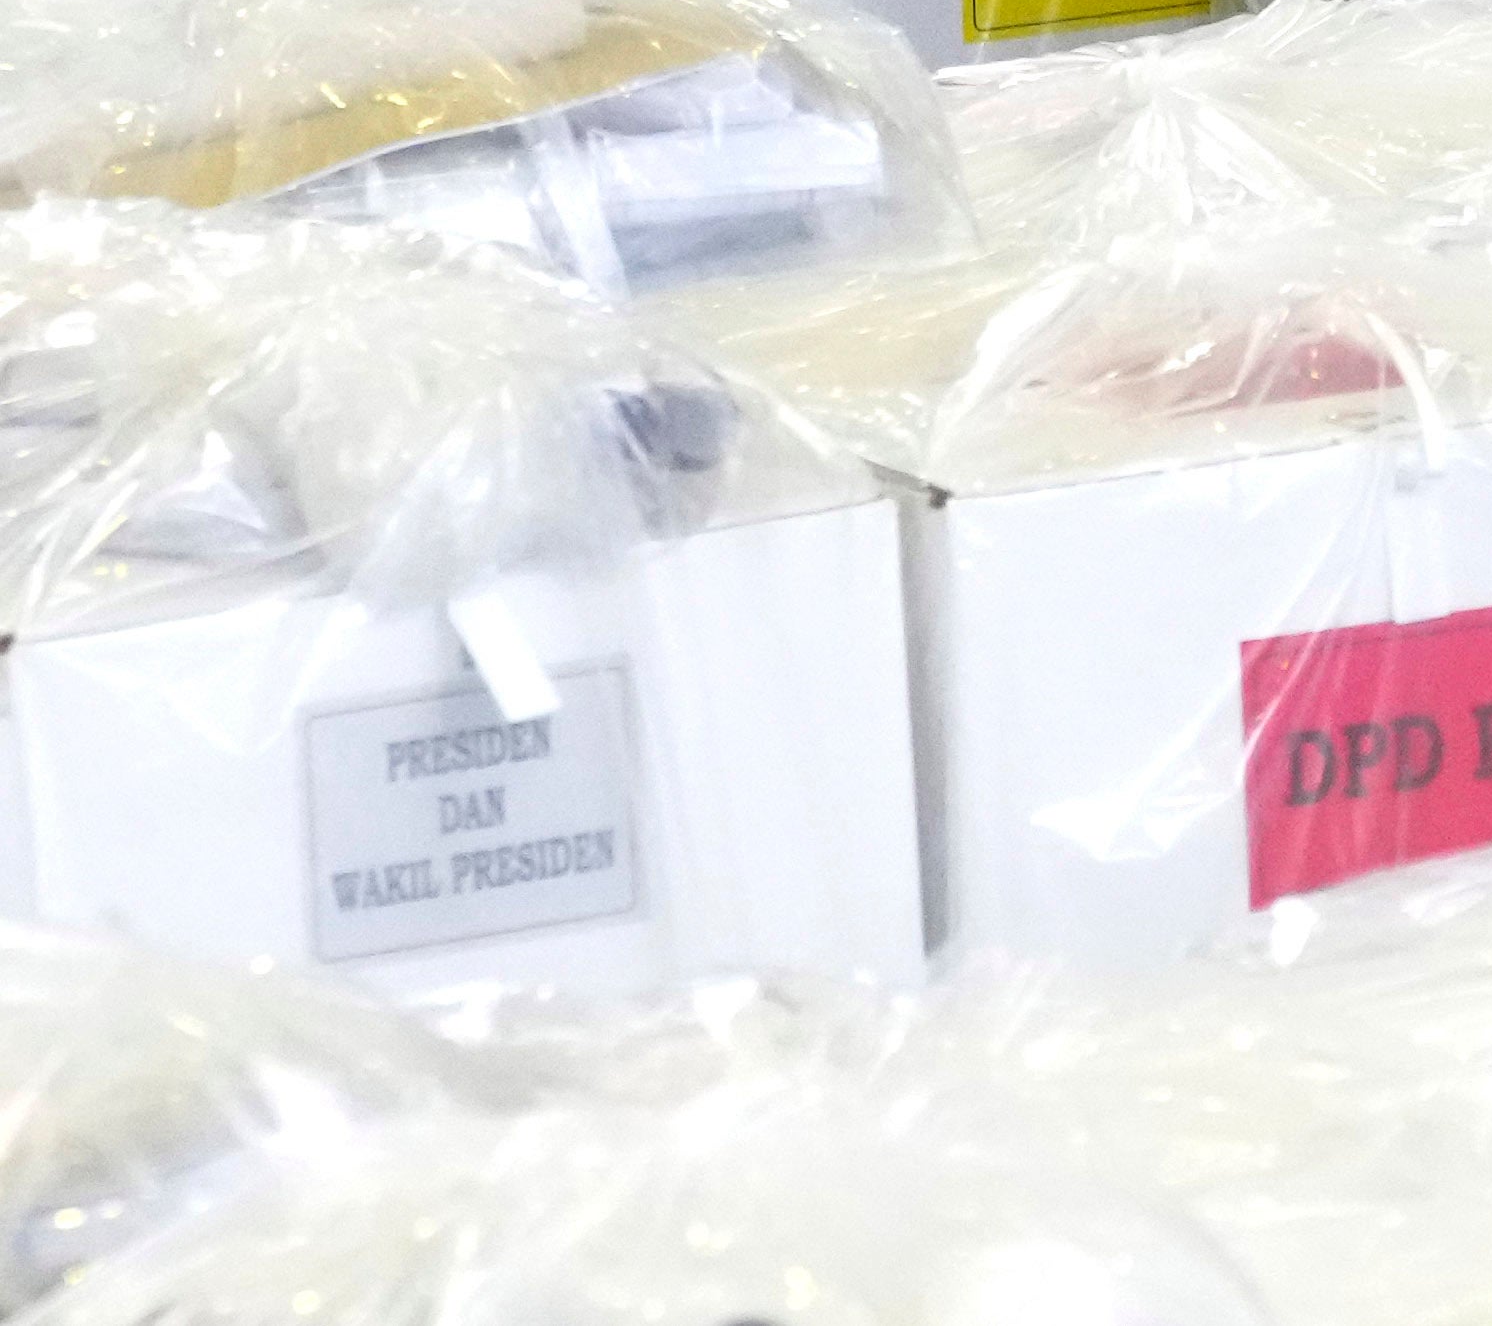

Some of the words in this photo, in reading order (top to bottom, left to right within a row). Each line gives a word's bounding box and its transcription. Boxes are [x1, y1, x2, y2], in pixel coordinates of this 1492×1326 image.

[386, 714, 553, 784] PRESIDEN
[1283, 713, 1446, 809] DPD
[437, 785, 506, 836] DAN
[332, 858, 441, 913] WAKIL
[450, 828, 616, 895] PRESIDEN
